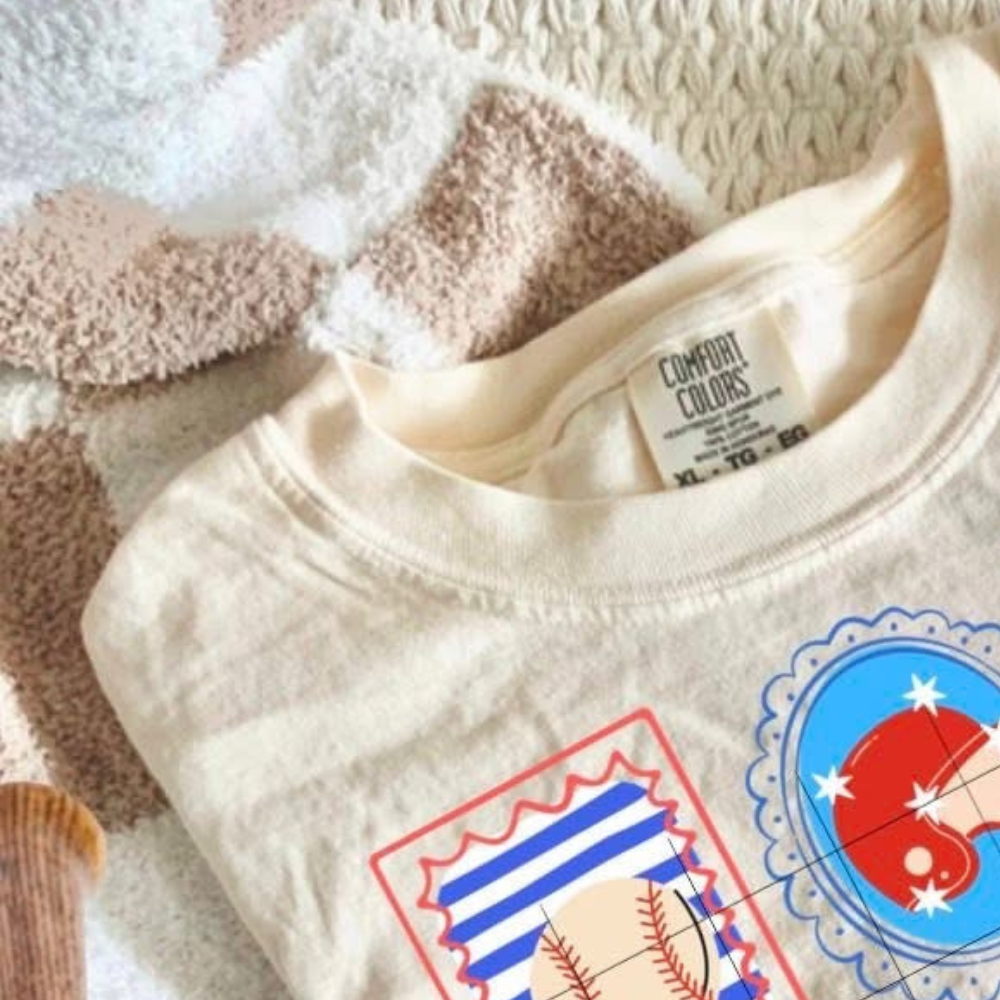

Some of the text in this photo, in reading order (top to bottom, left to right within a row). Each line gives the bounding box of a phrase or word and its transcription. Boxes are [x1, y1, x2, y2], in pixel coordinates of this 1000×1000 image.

[658, 330, 746, 388] COMFORT
[676, 367, 751, 420] COLORS
[673, 468, 705, 488] XL
[724, 447, 758, 470] TG
